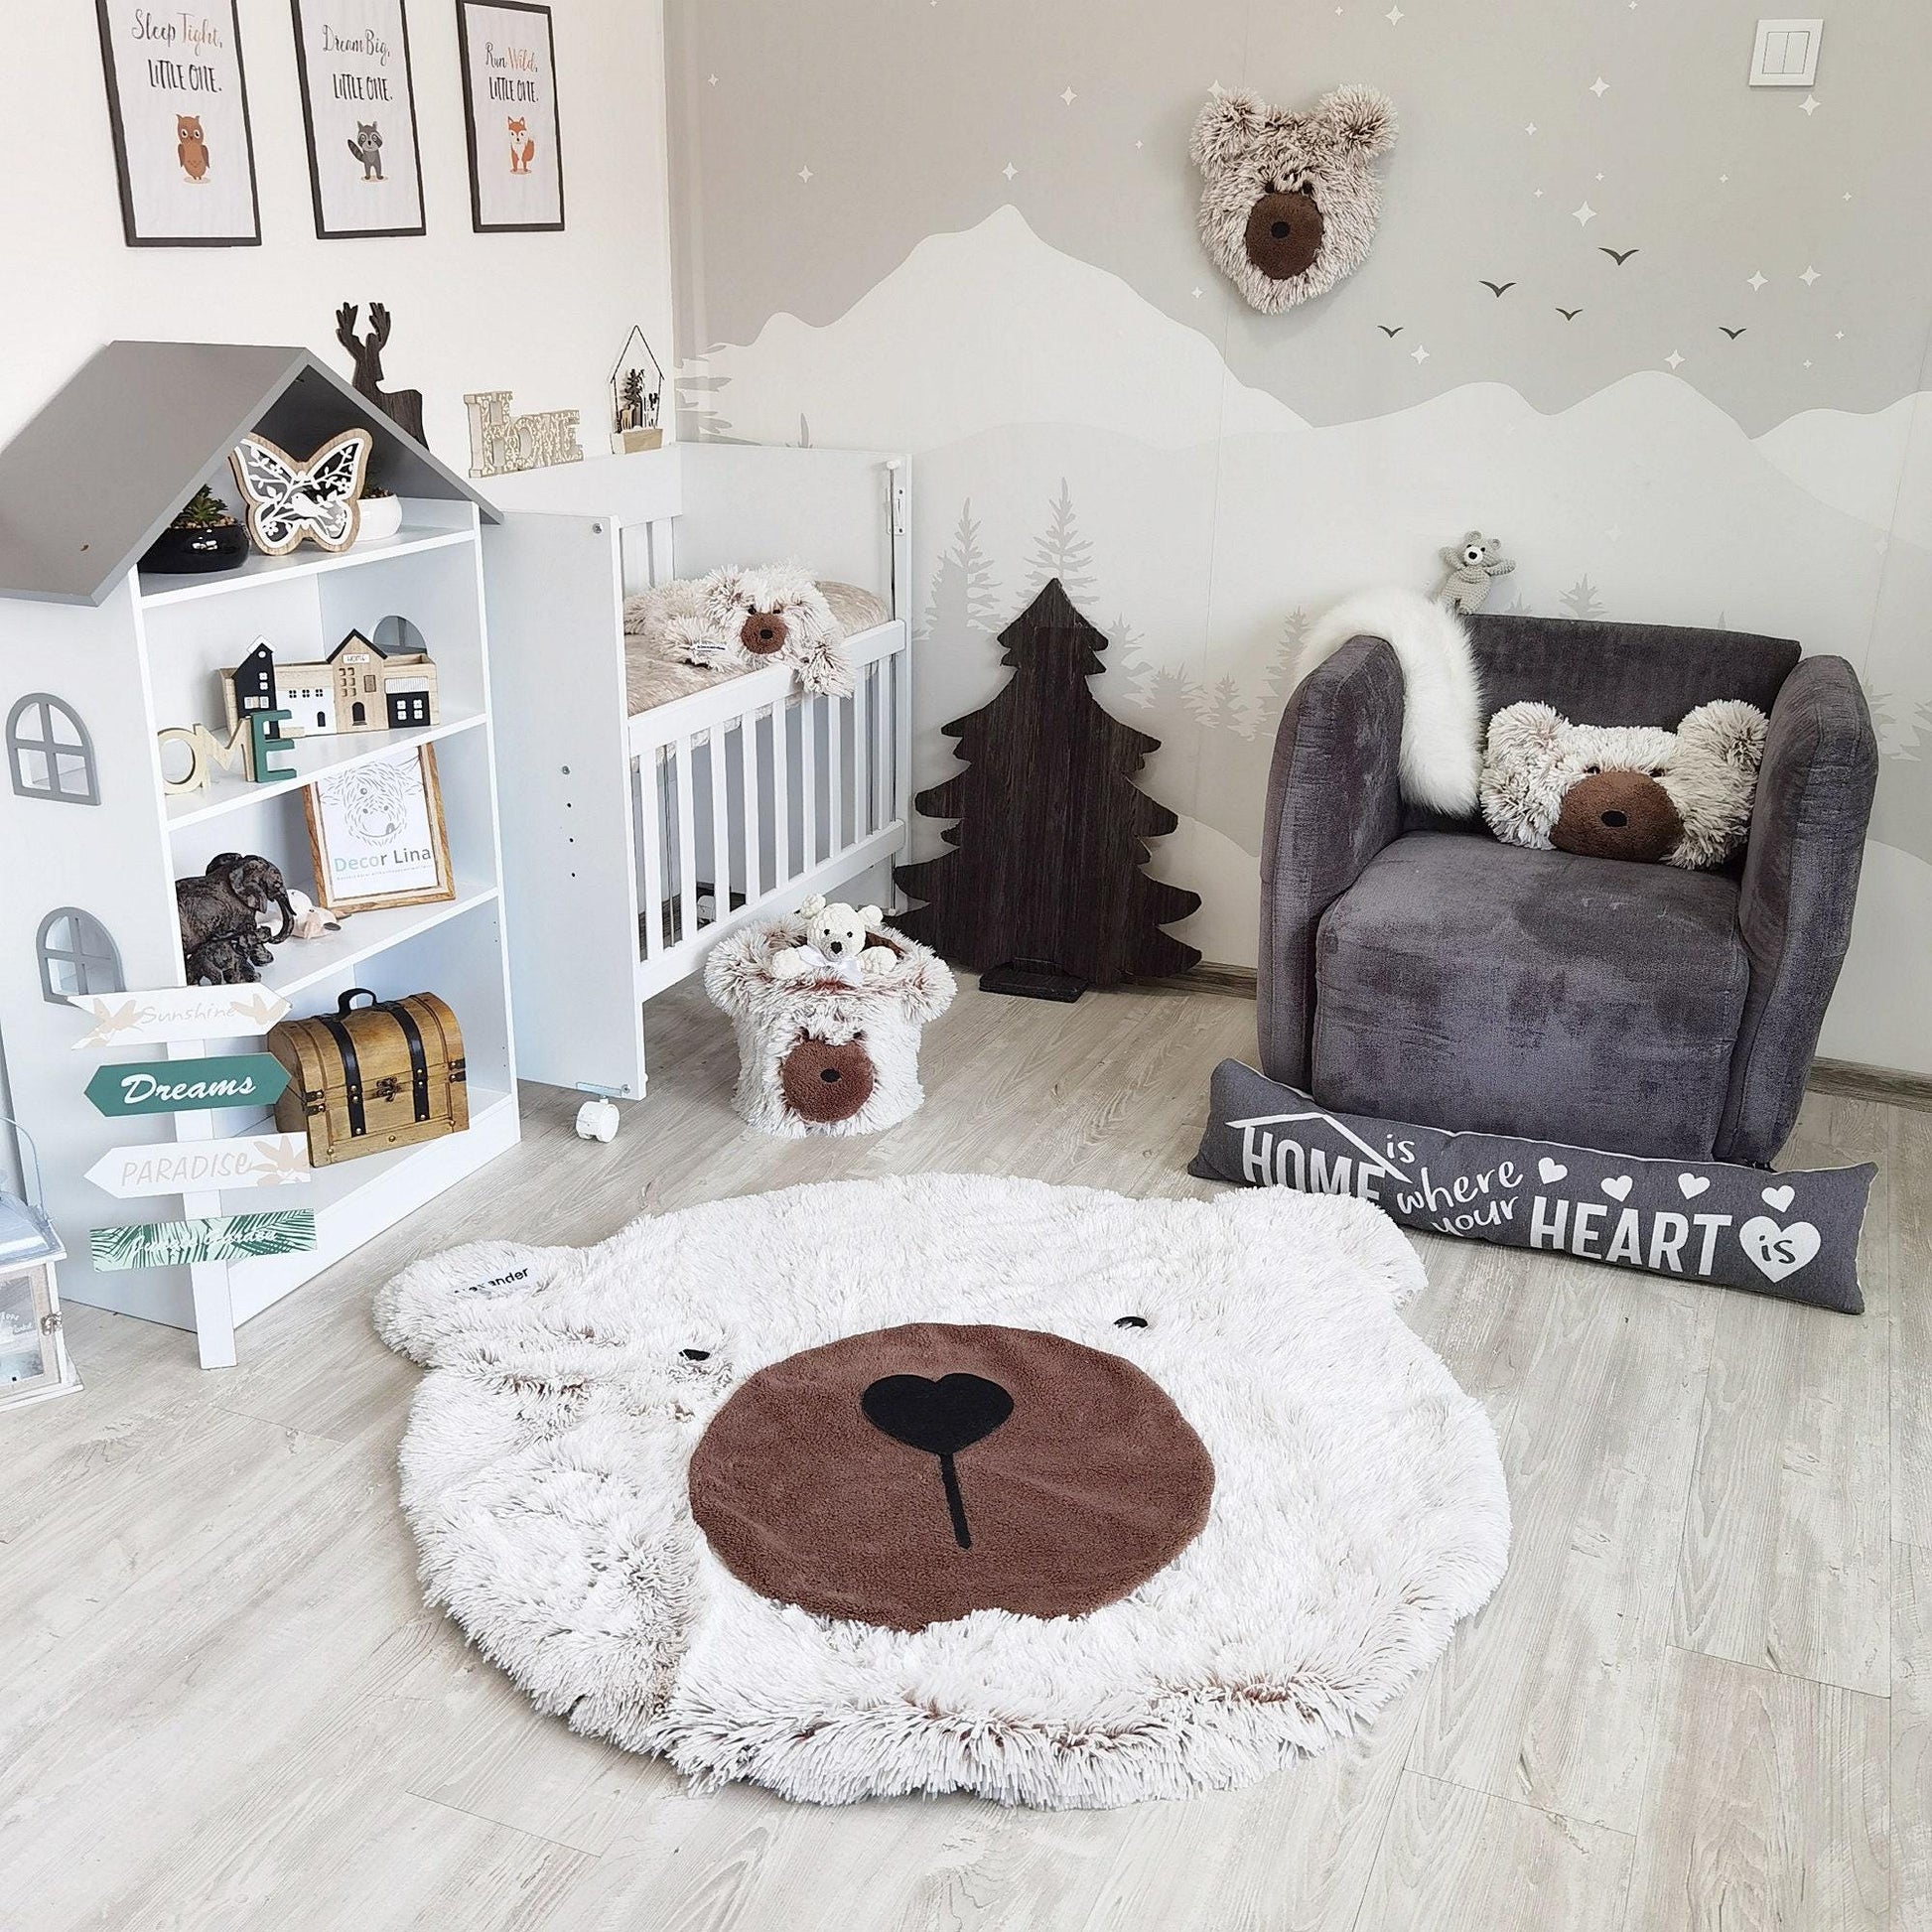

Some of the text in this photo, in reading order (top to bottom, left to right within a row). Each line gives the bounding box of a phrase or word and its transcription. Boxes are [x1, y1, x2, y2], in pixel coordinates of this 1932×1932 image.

[131, 8, 222, 57] Sleep Tight,
[322, 24, 390, 67] Dream Big,
[485, 42, 538, 72] Run Wild,
[147, 59, 222, 92] LITTLE ONE.
[333, 73, 393, 101] LITTLE ONE.
[488, 76, 539, 102] LITTLE ONE.
[334, 854, 387, 873] Decor
[393, 847, 432, 864] Lina
[141, 1001, 236, 1025] Sunshine
[120, 1073, 257, 1104] Dreams
[1241, 1125, 1416, 1201] HOME is
[1397, 1160, 1524, 1214] where
[1430, 1195, 1520, 1237] your
[1529, 1195, 1797, 1277] HEART is
